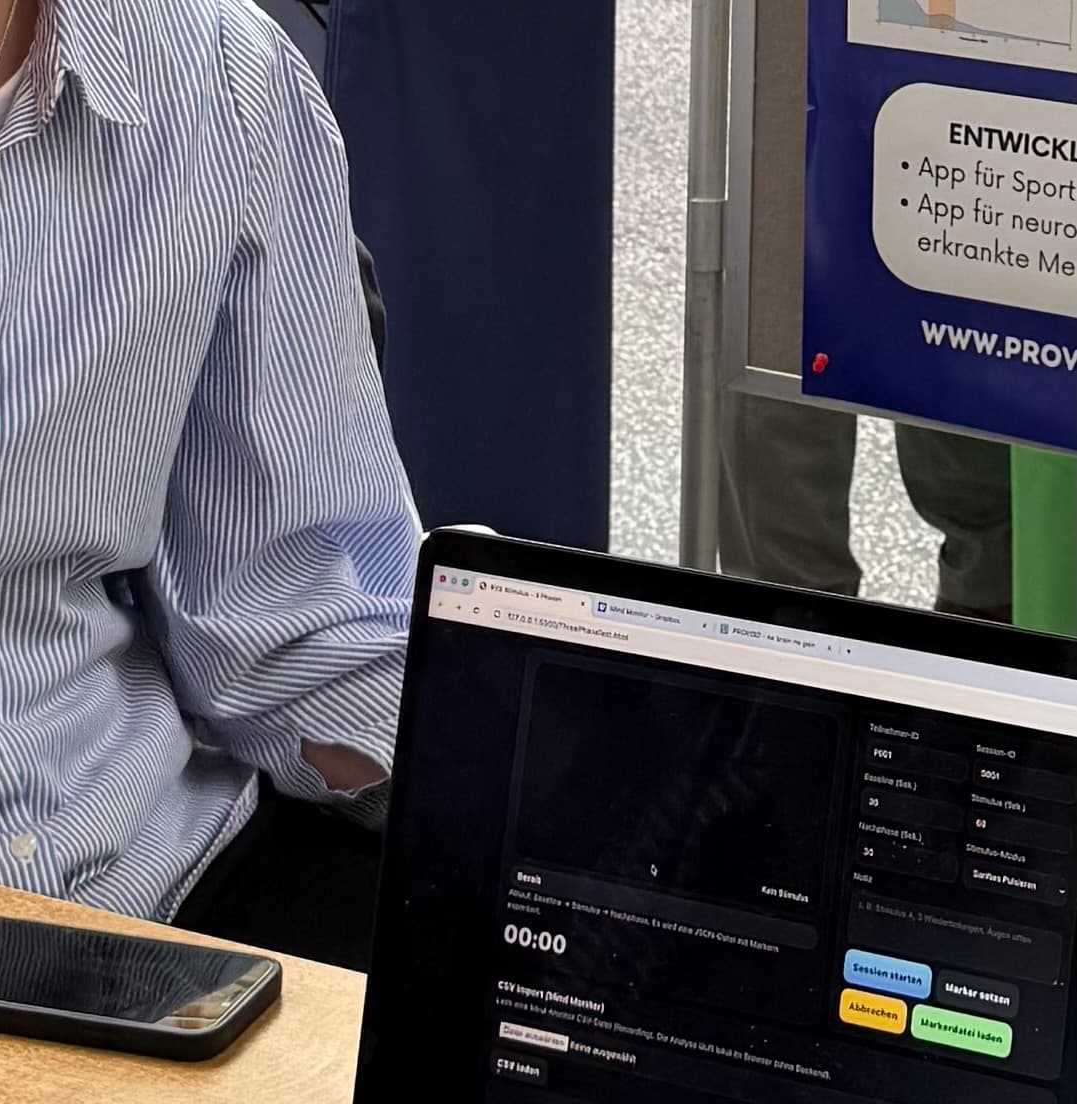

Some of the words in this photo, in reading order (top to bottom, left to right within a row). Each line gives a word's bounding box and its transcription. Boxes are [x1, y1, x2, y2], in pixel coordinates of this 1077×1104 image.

[918, 156, 965, 189] App
[975, 160, 1004, 189] für
[1012, 170, 1075, 201] Sport
[918, 194, 964, 227] App
[973, 198, 1004, 226] für
[1012, 214, 1077, 238] neuro
[917, 229, 1029, 269] erkrankte
[1039, 250, 1074, 277] Me
[503, 924, 567, 954] 00:00
[853, 962, 888, 978] Session
[890, 970, 922, 986] starten
[945, 982, 977, 999] Marker
[848, 1001, 898, 1021] Abbrechen
[977, 1029, 1003, 1044] laden
